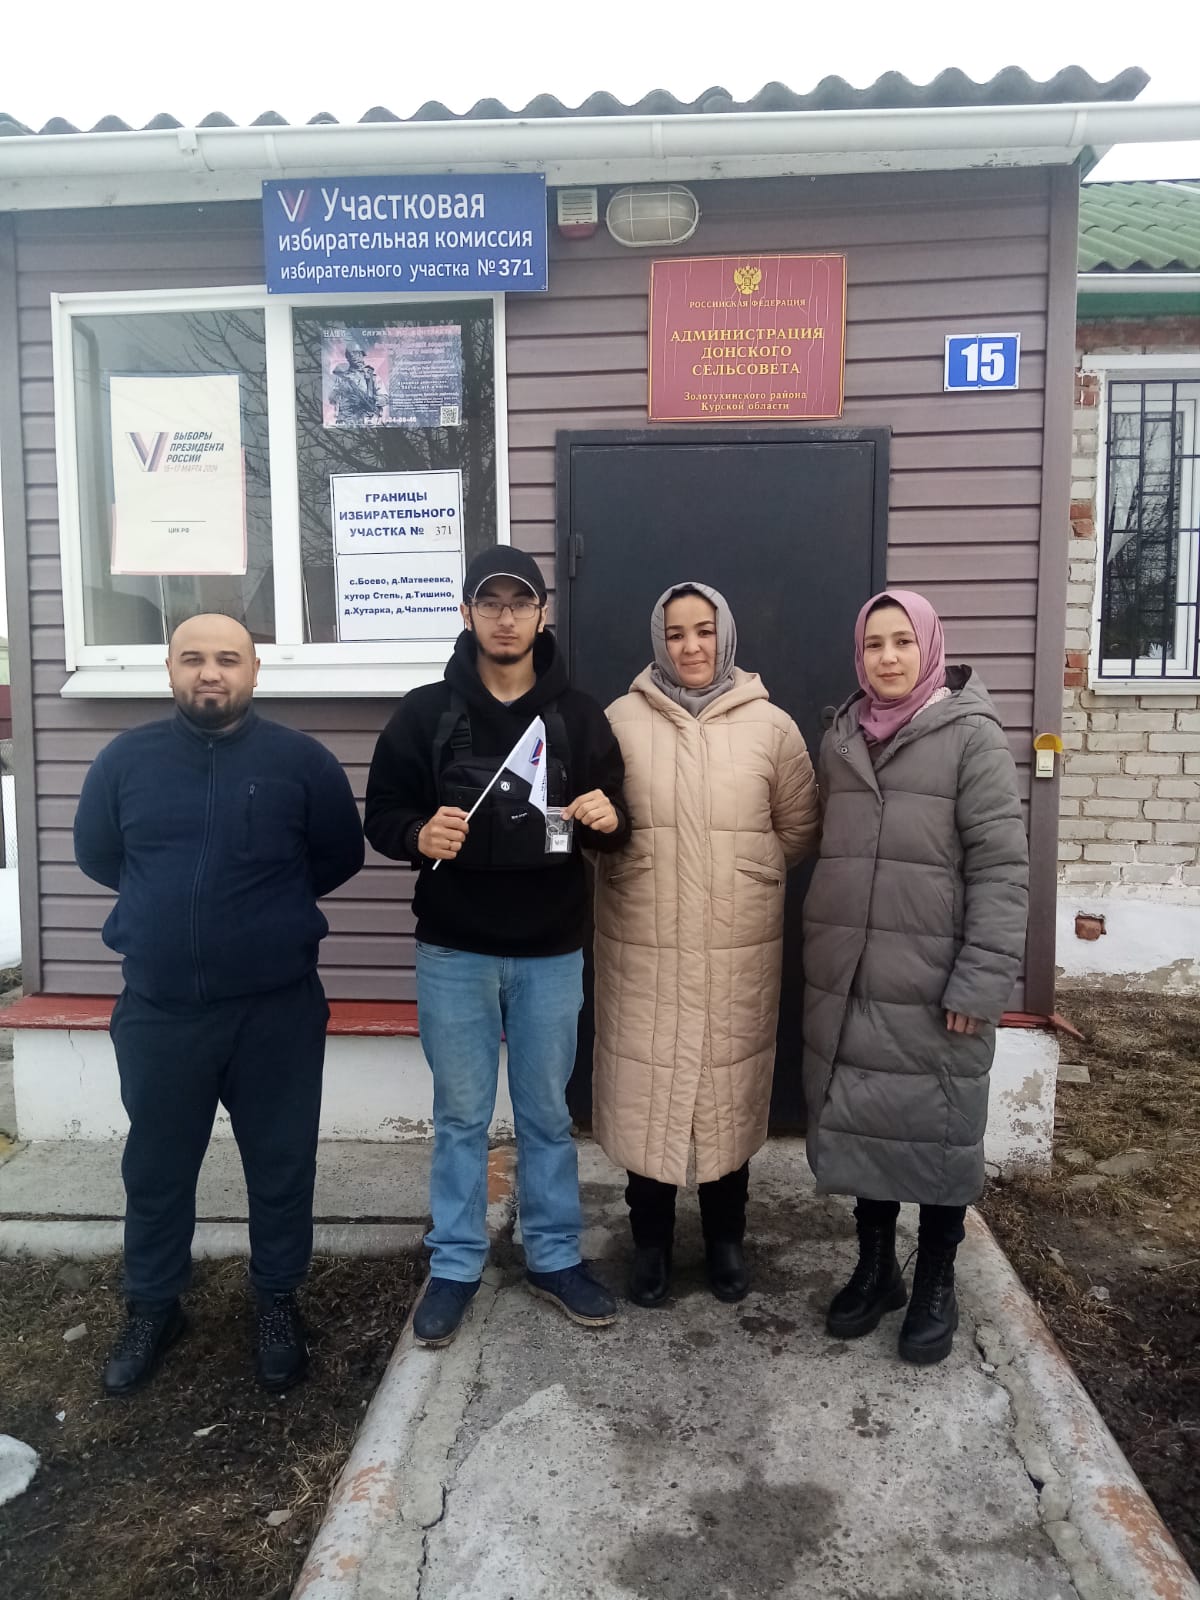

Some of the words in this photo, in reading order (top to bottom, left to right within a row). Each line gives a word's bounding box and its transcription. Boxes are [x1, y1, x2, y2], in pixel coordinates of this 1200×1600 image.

[321, 187, 486, 222] Участковая
[278, 227, 429, 257] избирательная
[434, 229, 533, 248] комиссия
[280, 260, 402, 284] избирательного
[409, 261, 469, 282] участка
[751, 299, 806, 308] ФЕДЕРАЦИЯ
[670, 327, 824, 343] АДМИНИСТРАЦИЯ
[701, 345, 792, 360] ДОНСКОГО
[961, 342, 1005, 382] 15
[692, 363, 800, 376] СЕЛЬСОВЕТА
[684, 391, 766, 402] Золотухинского
[770, 390, 807, 401] района
[701, 402, 744, 413] Курской
[748, 401, 789, 411] области
[173, 431, 213, 441] ВЫБОРЫ
[169, 442, 225, 453] ПРЕЗИДЕНТА
[166, 454, 202, 463] РОССИИ
[365, 492, 427, 503] ГРАНИЦЫ
[339, 508, 456, 521] ИЗБИРАТЕЛЬНОГО
[350, 527, 406, 537] УЧАСТКА
[410, 526, 425, 536] №
[435, 525, 452, 536] 371
[344, 593, 370, 602] хутор
